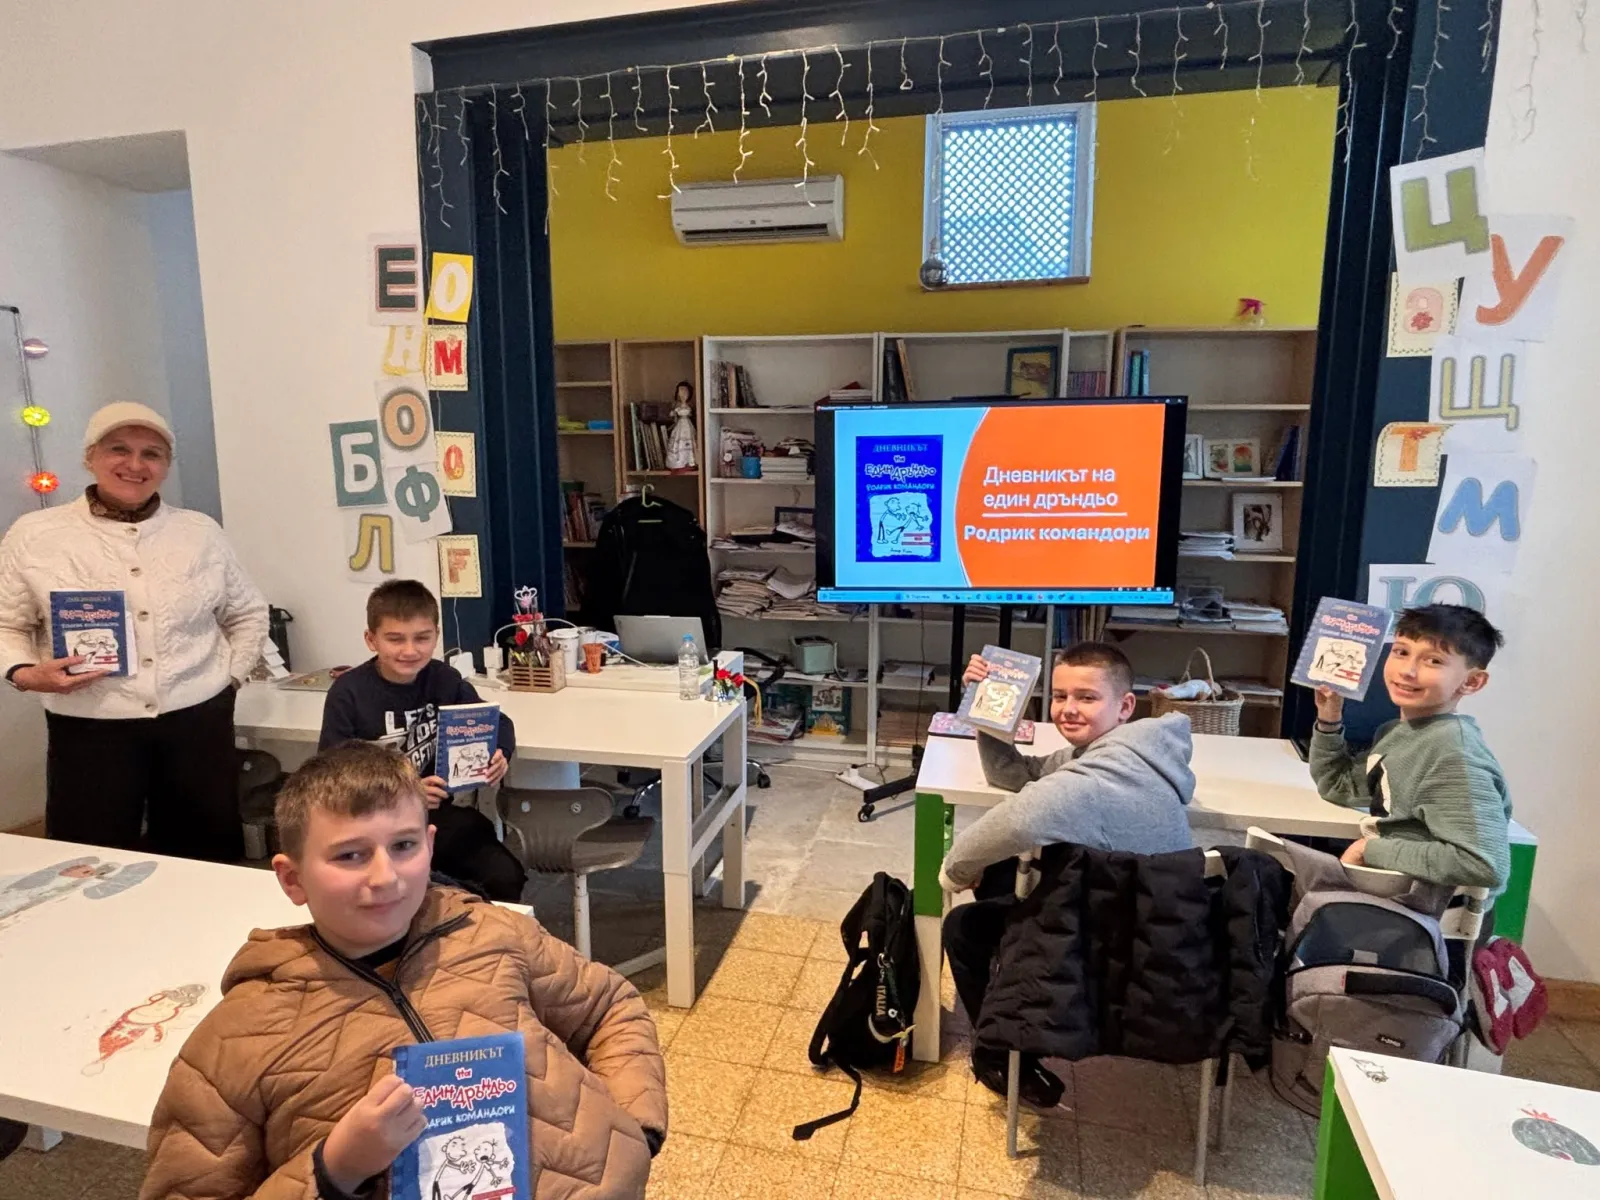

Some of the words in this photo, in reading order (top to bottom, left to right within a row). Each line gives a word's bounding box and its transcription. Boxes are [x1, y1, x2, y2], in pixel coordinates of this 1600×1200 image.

[1400, 166, 1489, 254] Ц
[375, 244, 418, 312] Е
[434, 261, 469, 314] О
[1475, 233, 1565, 326] У
[380, 386, 431, 452] О
[1439, 353, 1519, 432] Щ
[340, 432, 378, 494] Б
[983, 466, 1089, 486] Дневникът
[1092, 468, 1116, 483] на
[1388, 424, 1442, 472] Т
[395, 466, 441, 523] Ф
[983, 492, 1030, 509] един
[1033, 491, 1119, 511] дръндьо
[1437, 477, 1521, 541] М
[349, 514, 394, 574] Л
[963, 524, 1036, 543] Родрик
[1039, 525, 1151, 543] командори
[424, 1046, 504, 1068] ДНЕВНИКЪТ
[427, 1116, 453, 1129] ДРИК
[455, 1104, 516, 1124] КОМАНДОРИ
